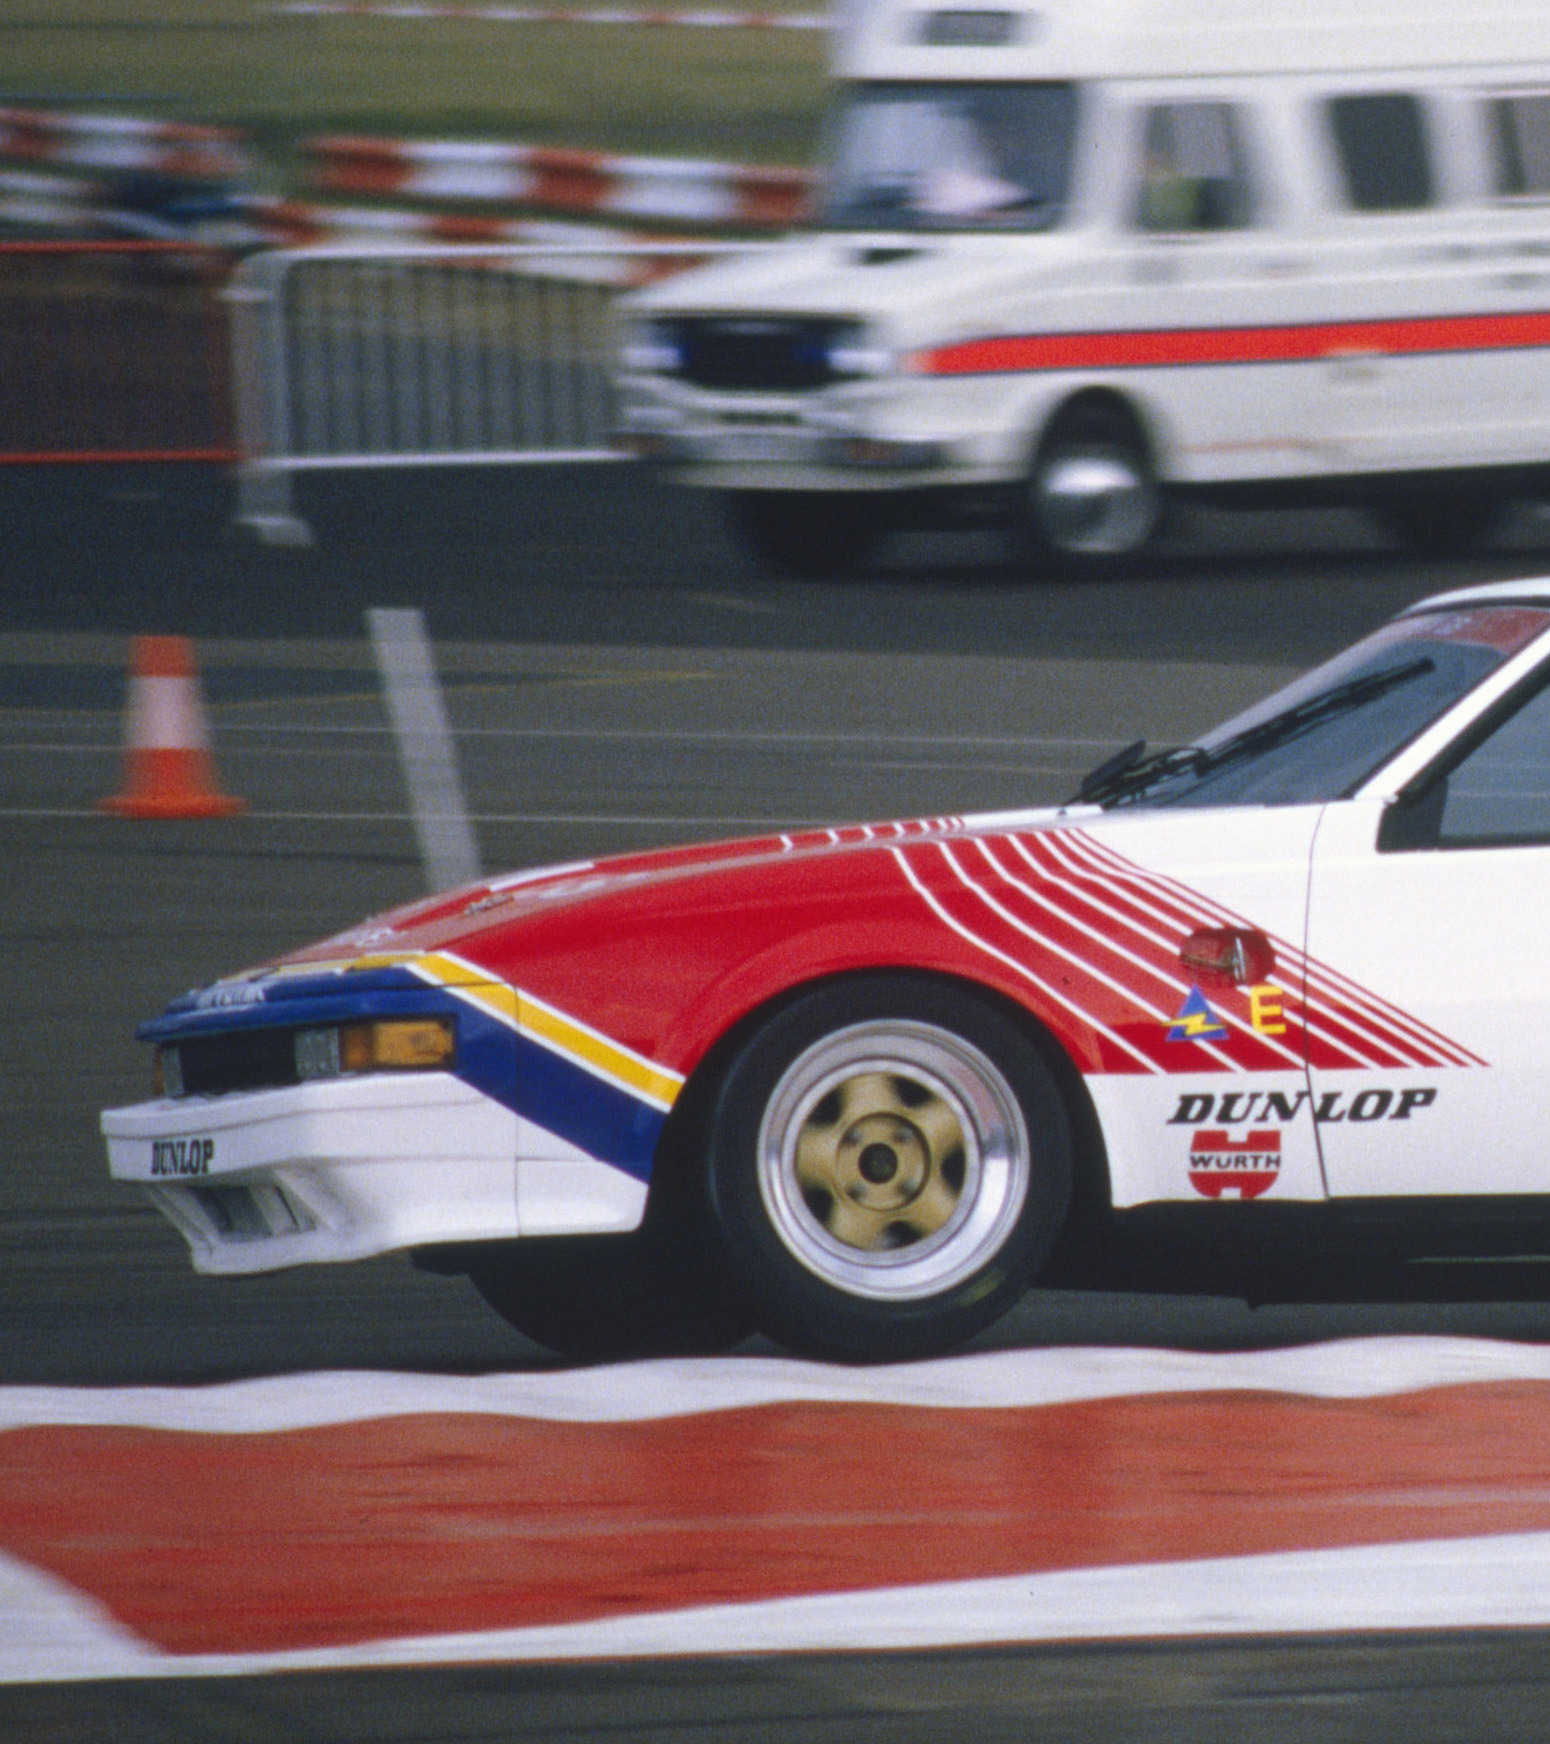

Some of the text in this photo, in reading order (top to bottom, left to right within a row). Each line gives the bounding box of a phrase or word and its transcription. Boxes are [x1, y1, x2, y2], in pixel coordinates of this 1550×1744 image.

[1250, 984, 1286, 1034] E
[1167, 1088, 1437, 1125] DUNLOP
[151, 1139, 214, 1175] DUNLOP
